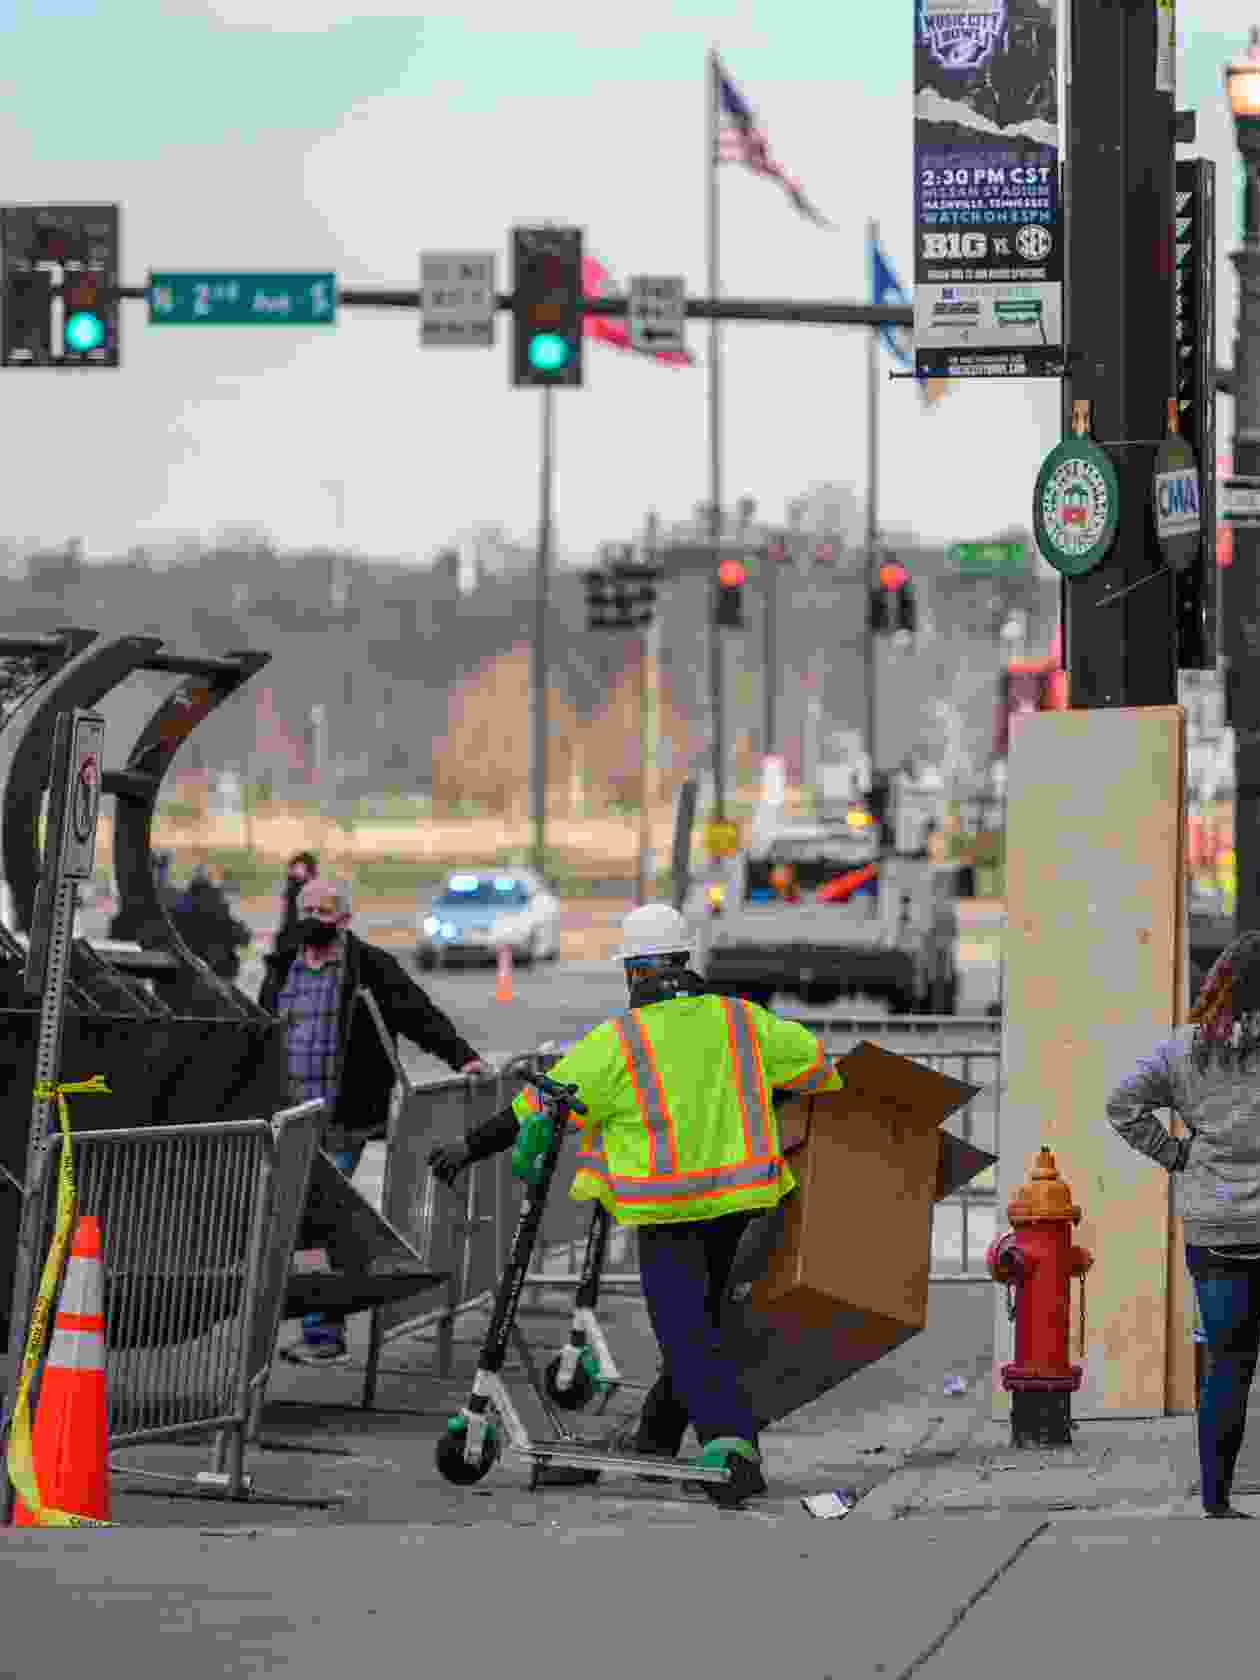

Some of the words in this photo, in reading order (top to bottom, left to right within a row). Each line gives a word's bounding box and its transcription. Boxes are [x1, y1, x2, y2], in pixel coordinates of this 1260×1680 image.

[922, 168, 969, 186] 2:30
[974, 167, 1004, 186] PM
[1009, 167, 1050, 186] CST
[983, 184, 1049, 197] STADIUM
